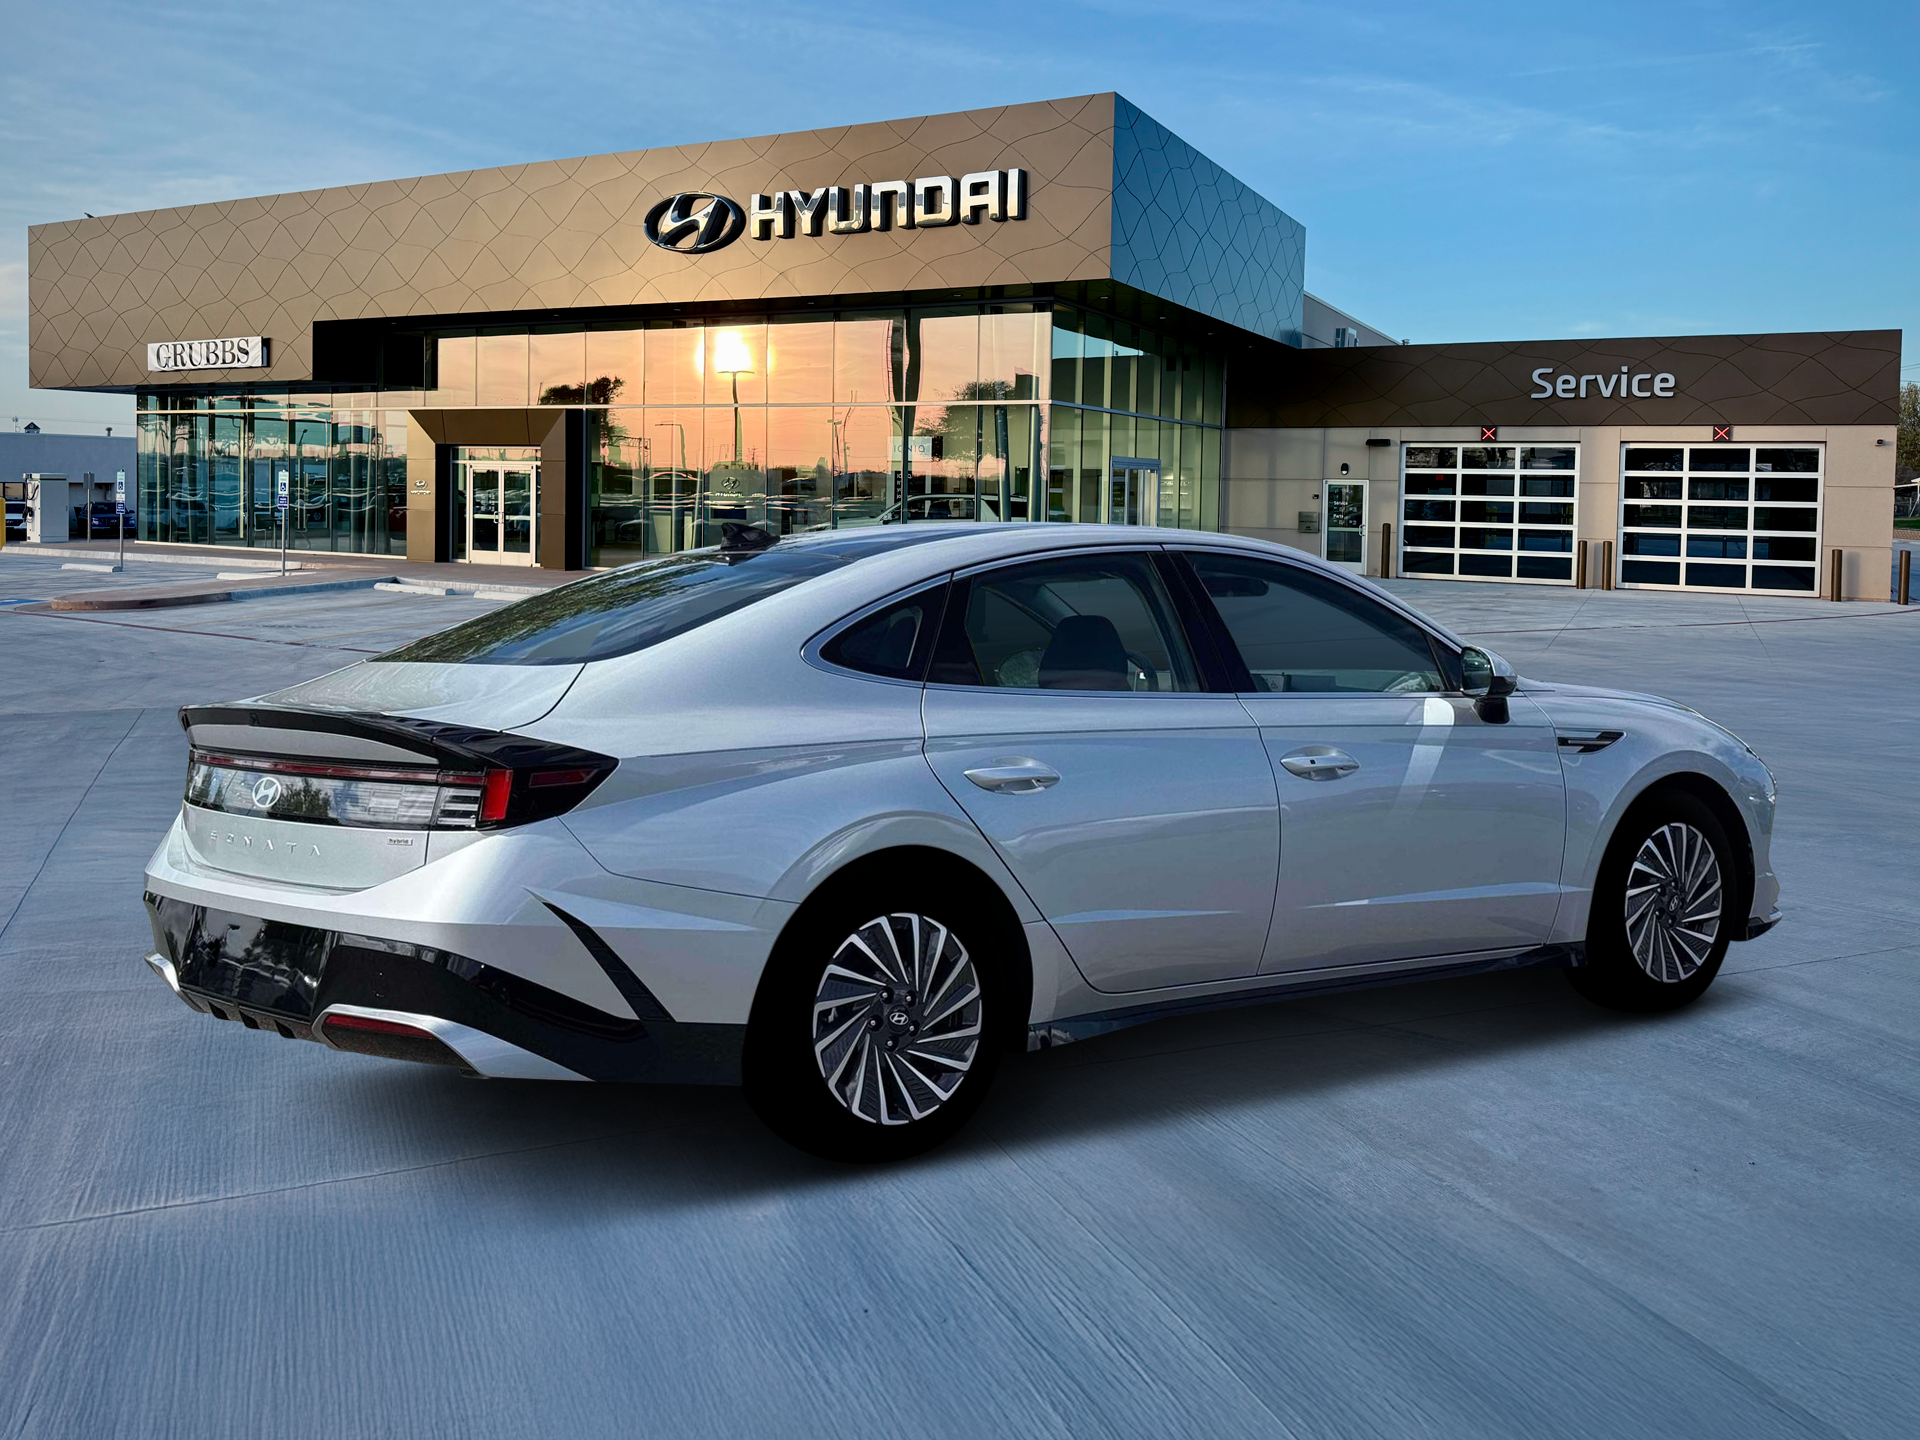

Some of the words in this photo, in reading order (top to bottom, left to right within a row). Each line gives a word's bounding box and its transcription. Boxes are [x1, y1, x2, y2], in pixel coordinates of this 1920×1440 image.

[750, 168, 1026, 241] HYUNDAI
[156, 338, 250, 369] GRUBBS
[1530, 365, 1676, 399] Service
[210, 830, 321, 857] SONATA
